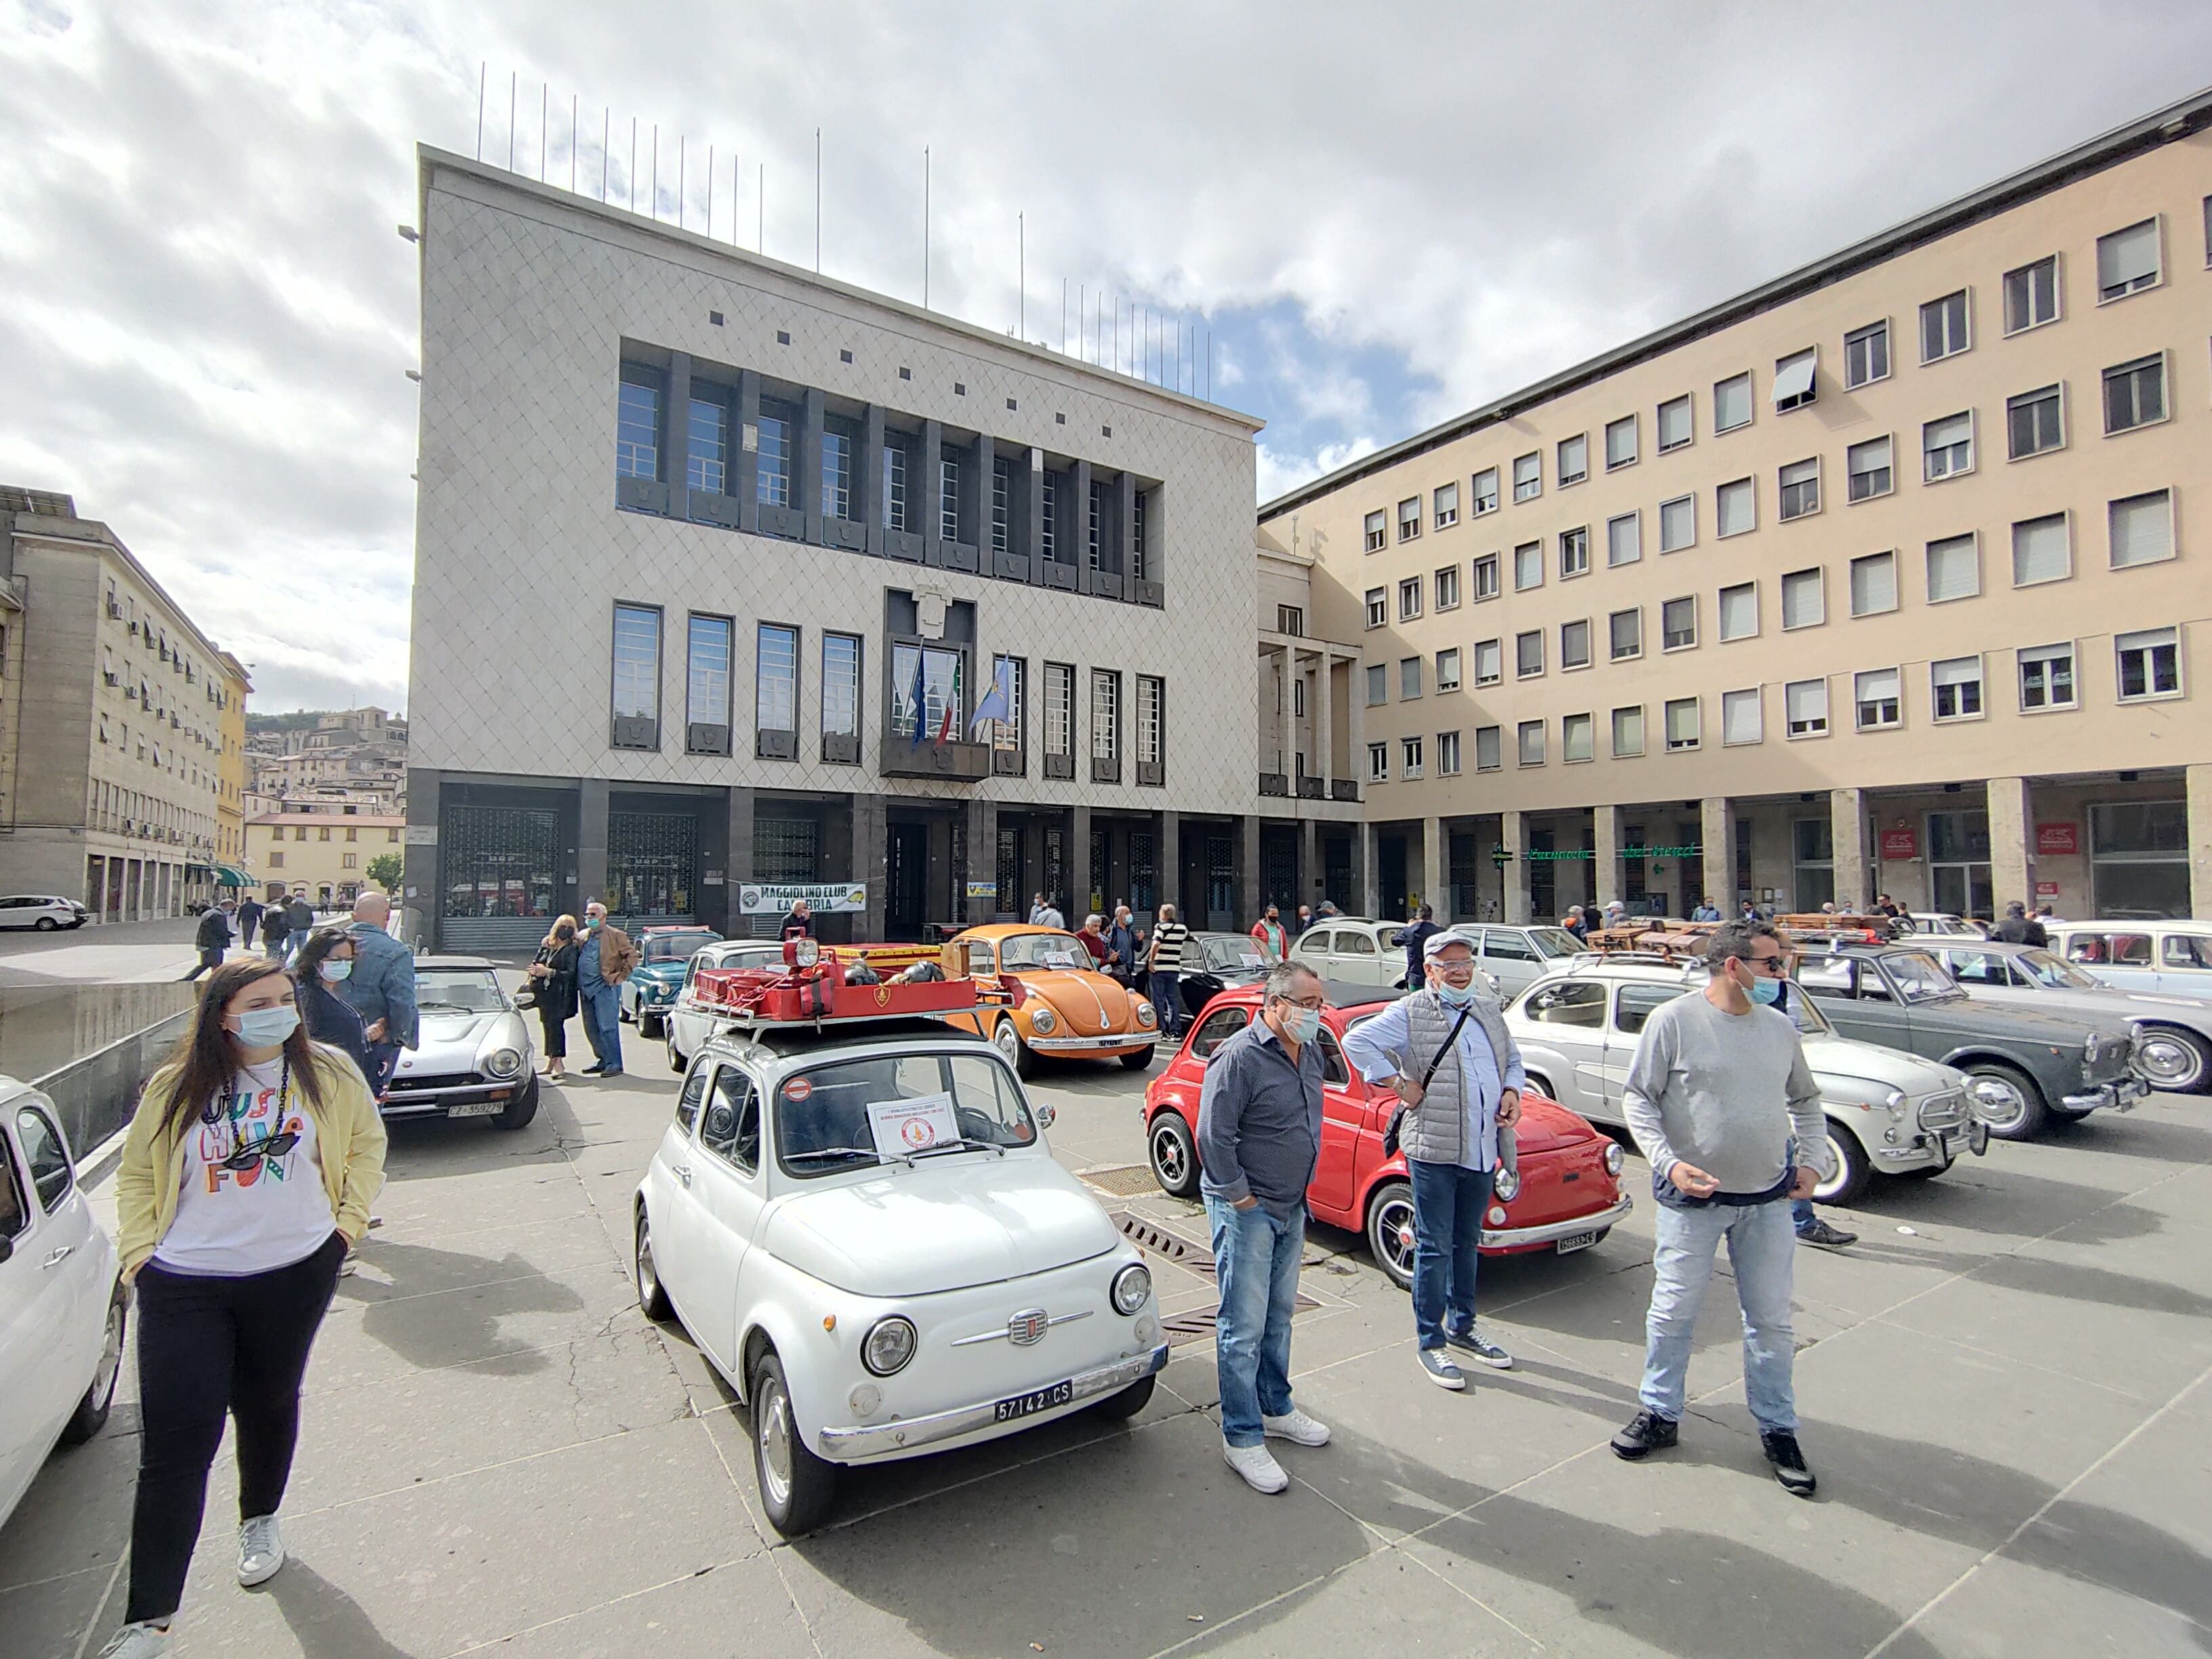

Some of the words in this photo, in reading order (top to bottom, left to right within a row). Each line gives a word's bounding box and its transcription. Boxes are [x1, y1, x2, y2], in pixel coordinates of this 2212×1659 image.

[760, 886, 821, 899] MAGGIOLINO
[824, 886, 847, 897] CLUB
[777, 899, 833, 911] CABRIA
[1053, 1384, 1069, 1404] CS
